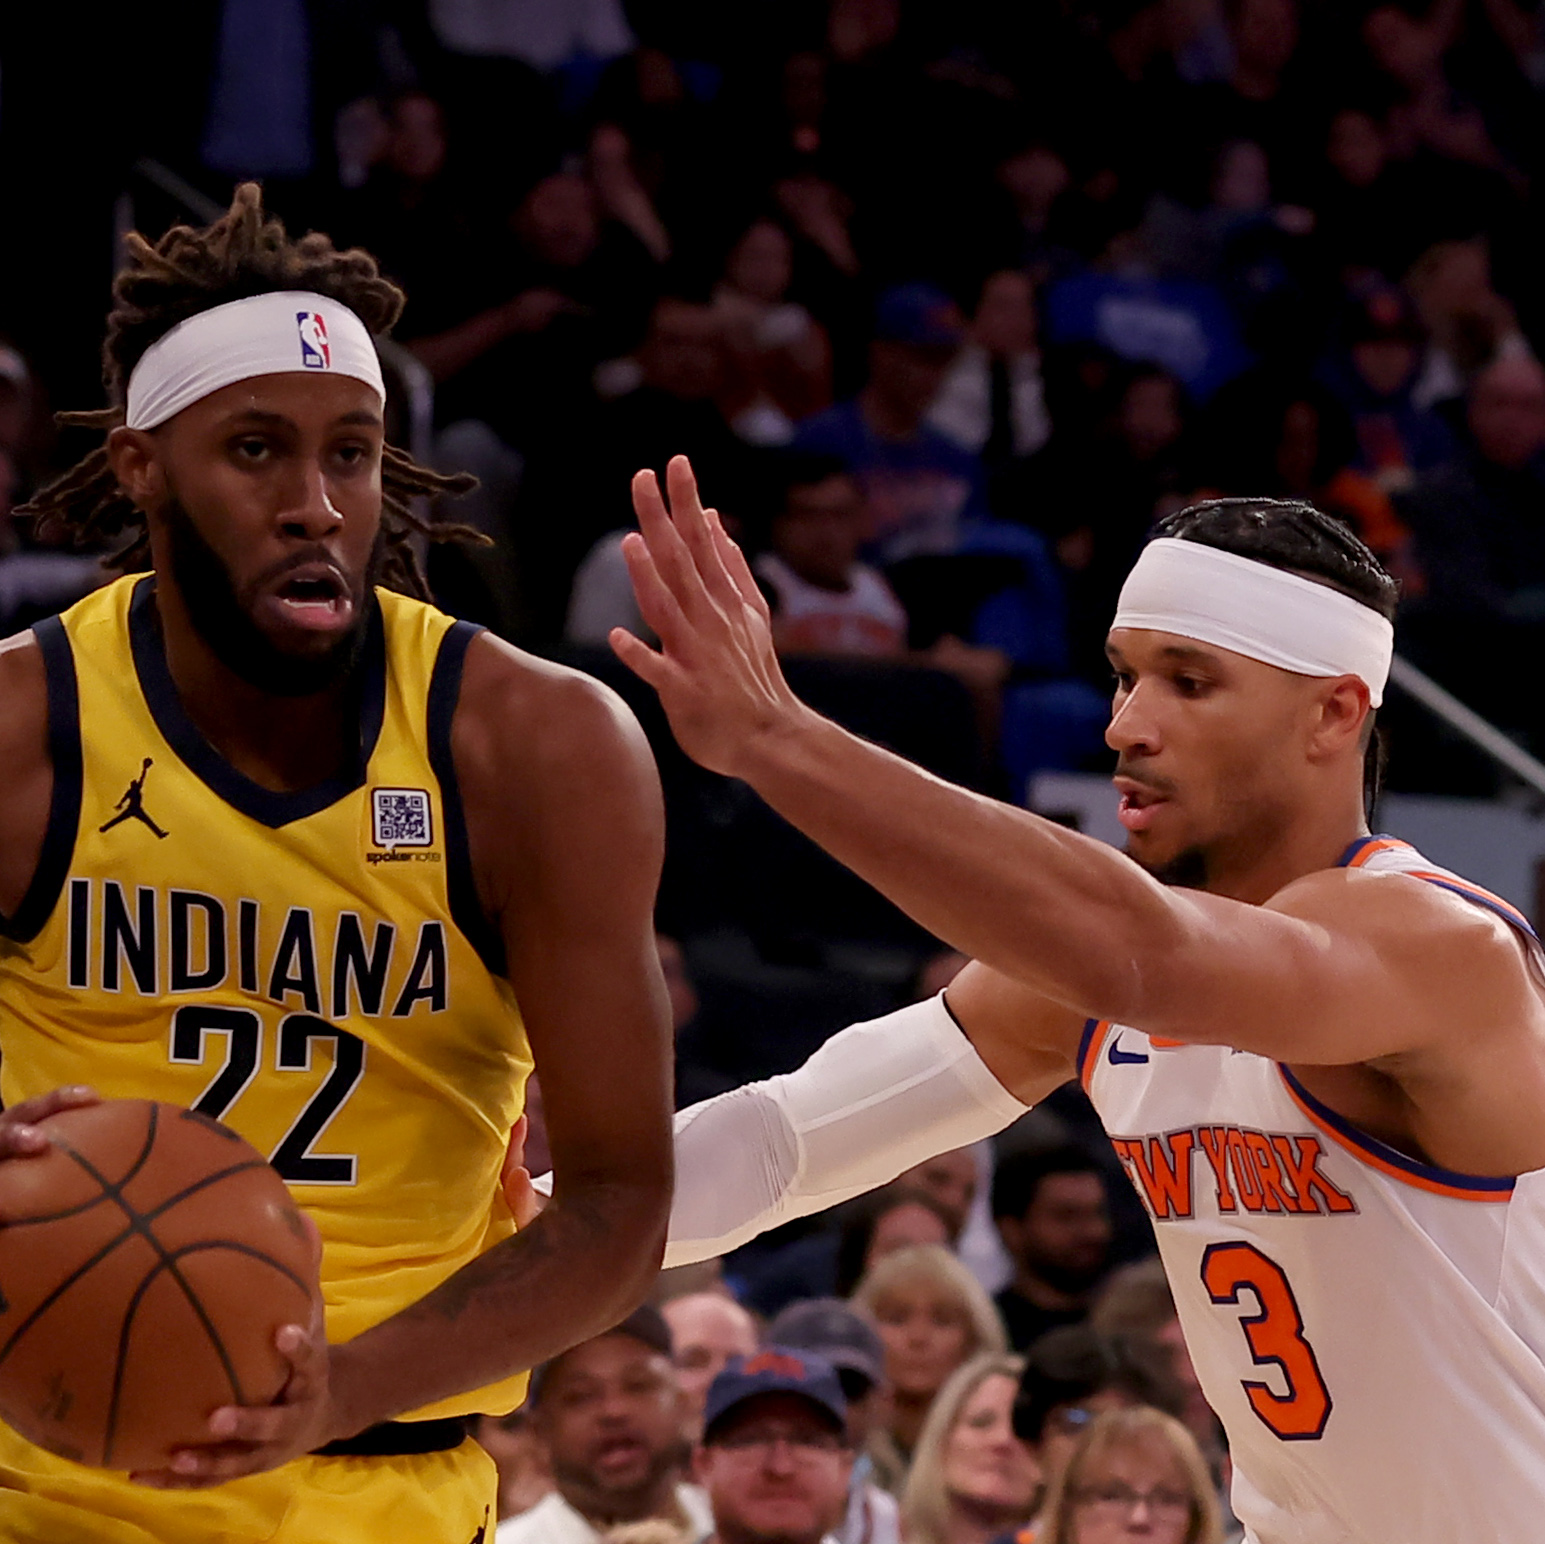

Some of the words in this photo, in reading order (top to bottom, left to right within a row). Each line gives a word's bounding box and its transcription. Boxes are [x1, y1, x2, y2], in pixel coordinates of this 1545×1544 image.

[66, 877, 449, 1021] INDIANA
[168, 1005, 367, 1187] 22
[1194, 1123, 1361, 1217] YORK
[1200, 1240, 1333, 1441] 3
